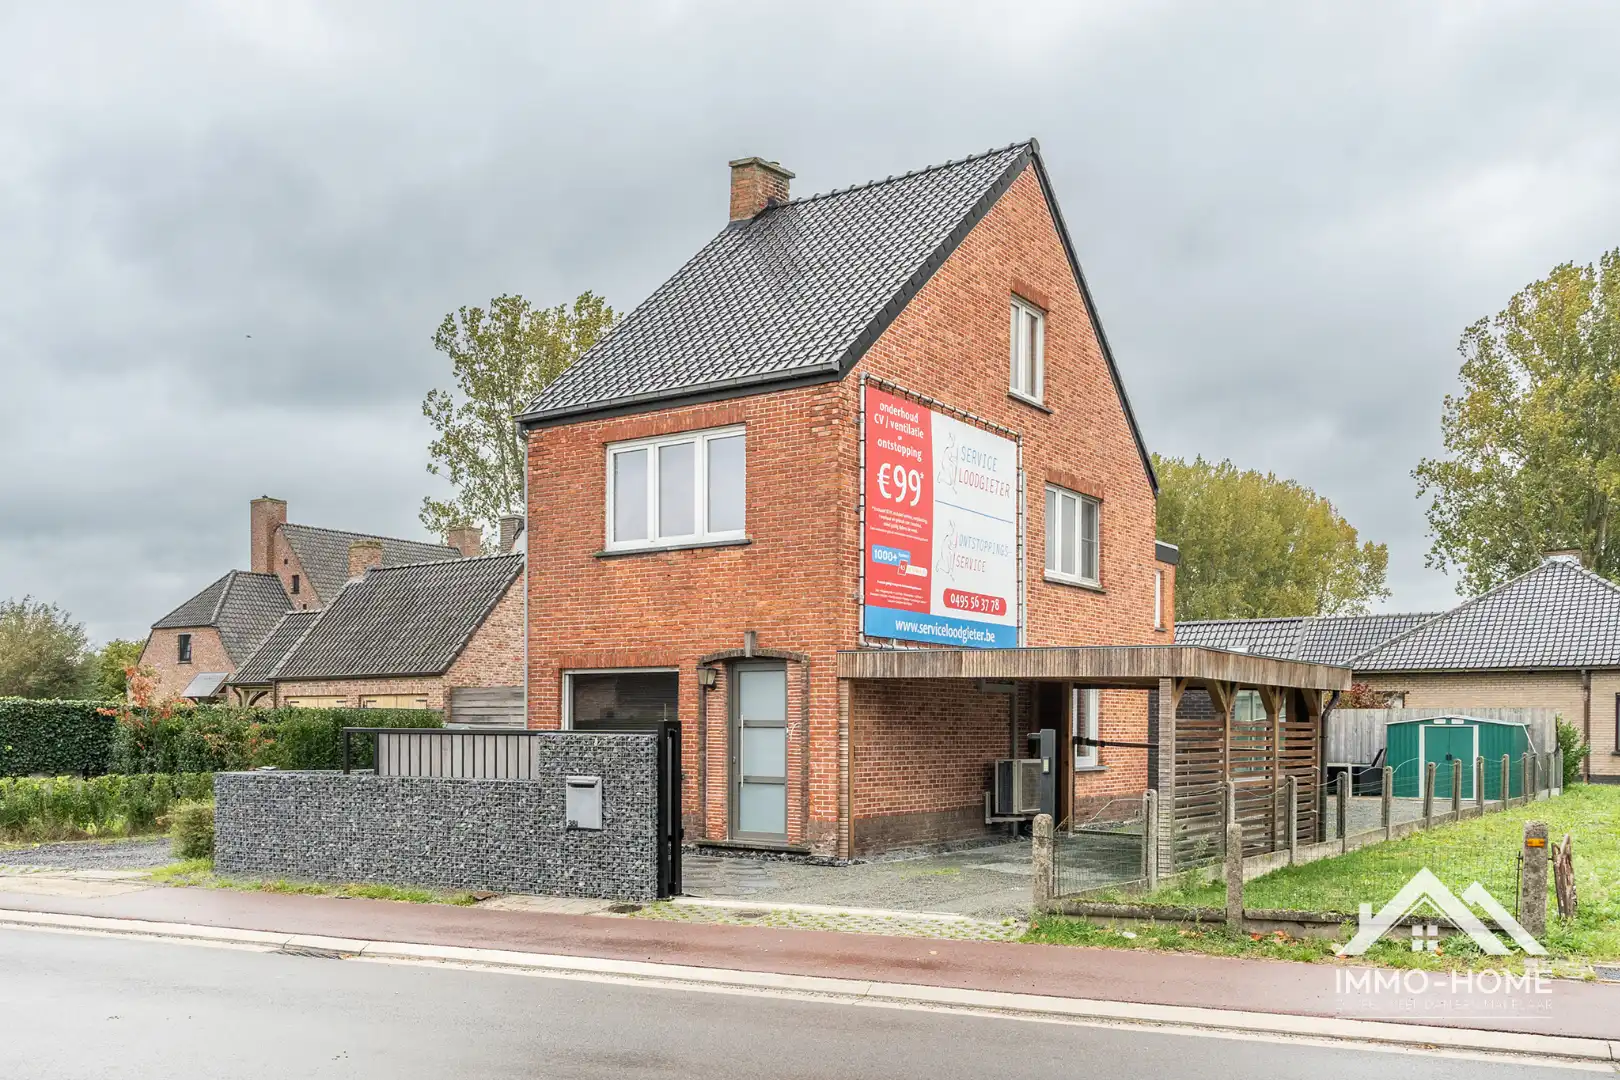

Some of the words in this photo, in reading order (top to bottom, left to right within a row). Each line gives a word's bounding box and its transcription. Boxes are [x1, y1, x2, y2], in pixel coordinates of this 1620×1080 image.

[874, 413, 885, 425] CV
[890, 418, 924, 438] ventilatie
[879, 402, 919, 424] onderhoud
[877, 438, 923, 463] ontstopping
[961, 445, 998, 473] SERVICE
[958, 469, 1011, 499] LOODGIETER
[873, 548, 898, 562] 1000+
[956, 554, 987, 573] SERVICE
[950, 593, 969, 609] 0495
[970, 595, 980, 610] 56
[980, 597, 989, 612] 37
[991, 598, 1000, 613] 78
[895, 618, 996, 644] www.serviceloodgieter.be
